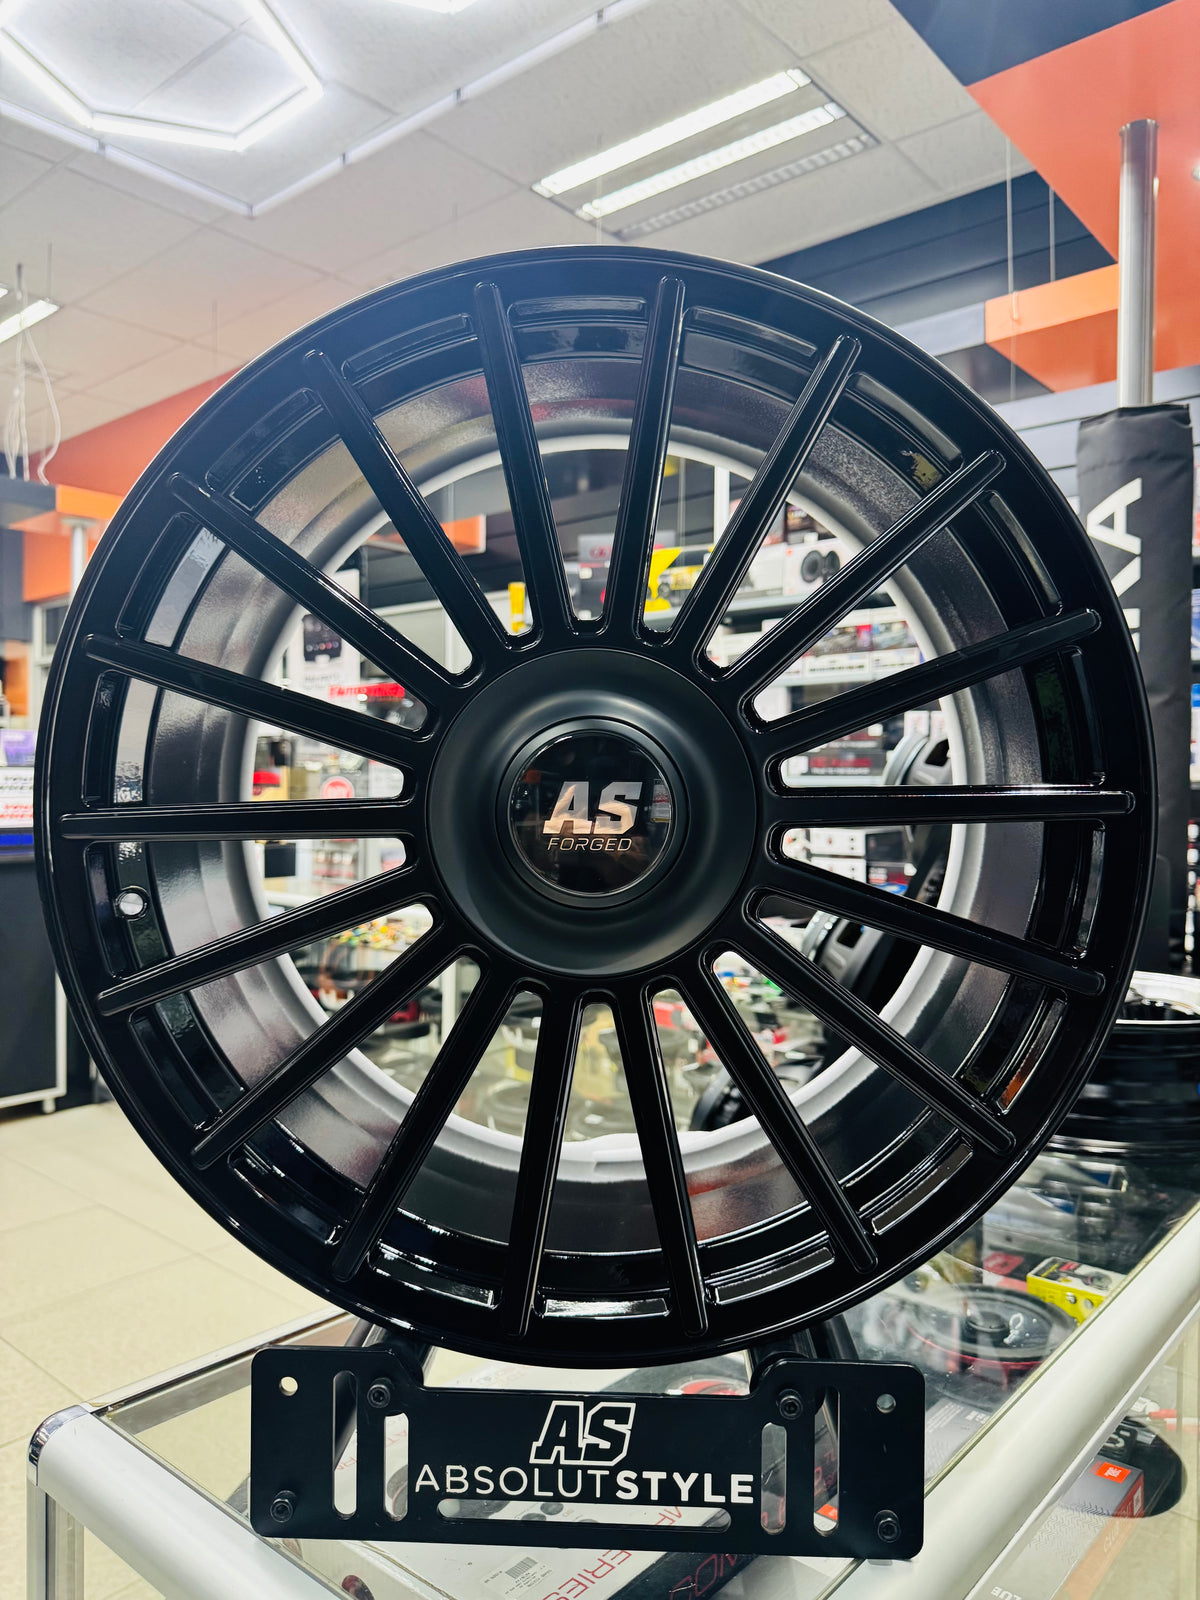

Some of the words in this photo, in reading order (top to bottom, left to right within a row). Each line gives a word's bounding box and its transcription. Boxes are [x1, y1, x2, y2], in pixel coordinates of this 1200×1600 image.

[542, 781, 643, 836] AS
[547, 837, 633, 853] FORGED
[529, 1401, 636, 1465] AS
[414, 1464, 754, 1505] ABSOLUTSTYLE
